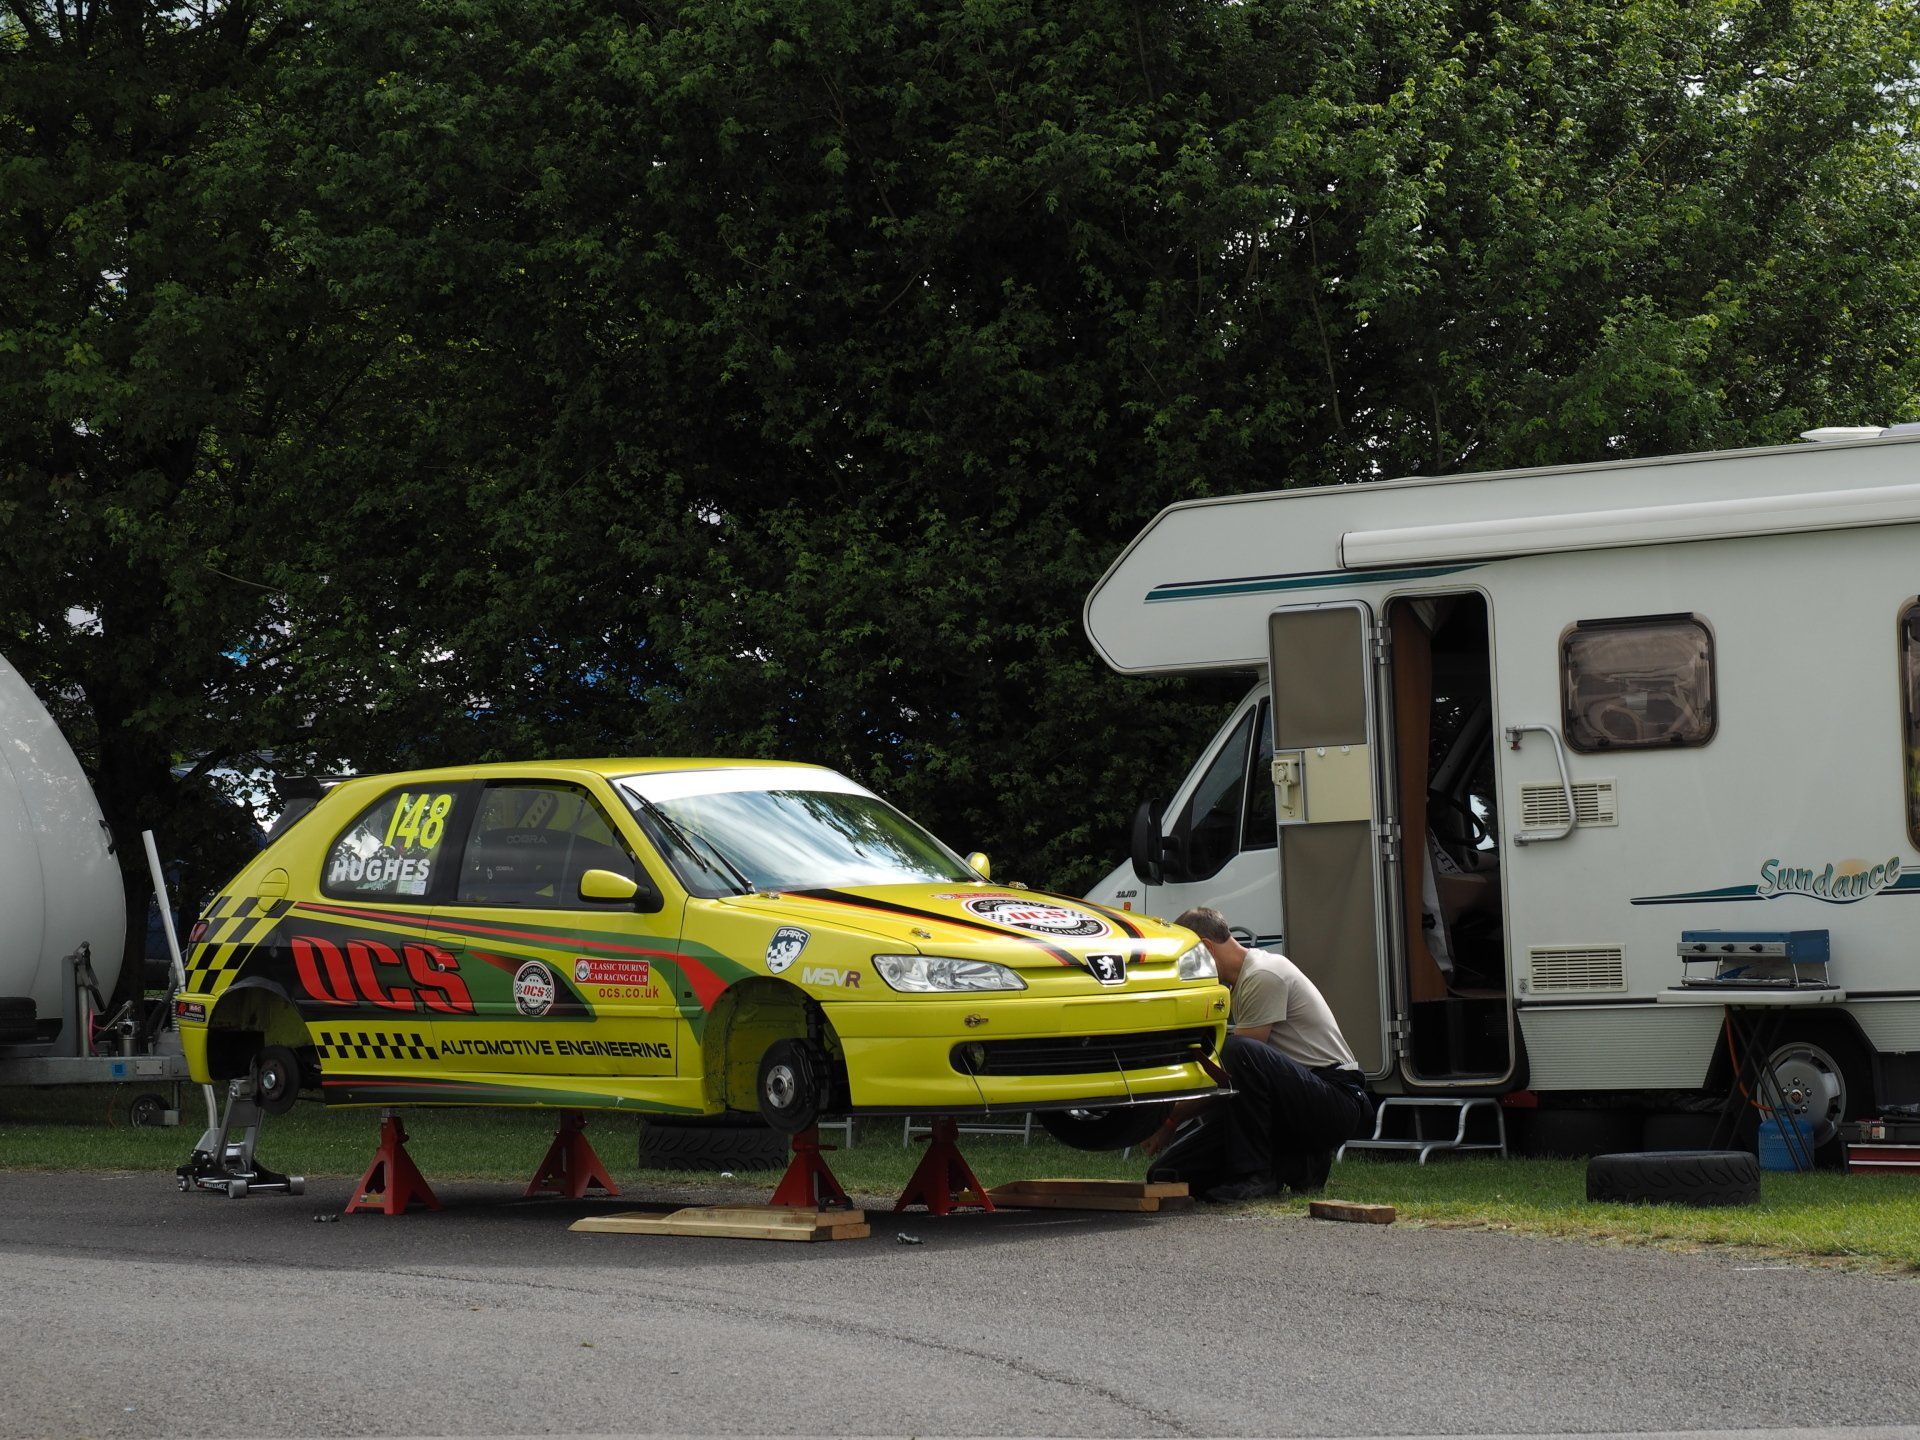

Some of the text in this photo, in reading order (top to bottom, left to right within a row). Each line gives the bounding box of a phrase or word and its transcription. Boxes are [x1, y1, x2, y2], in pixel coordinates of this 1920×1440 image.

[384, 793, 452, 849] 148
[506, 834, 548, 844] COBRA
[331, 858, 431, 881] HUGHES
[1758, 856, 1900, 899] Sundance
[1009, 909, 1067, 921] OCS
[778, 929, 806, 943] BARC
[291, 936, 476, 1014] OCS
[521, 966, 549, 984] AUTOMOTIVE
[589, 962, 648, 972] CLASSIC TOURING
[603, 973, 629, 982] RACING
[629, 975, 648, 983] CLUB
[801, 966, 862, 989] MSVR
[523, 984, 546, 997] OCS
[598, 985, 659, 998] ocs.co.uk
[441, 1040, 672, 1059] AUTOMOTIVE ENGINEERING
